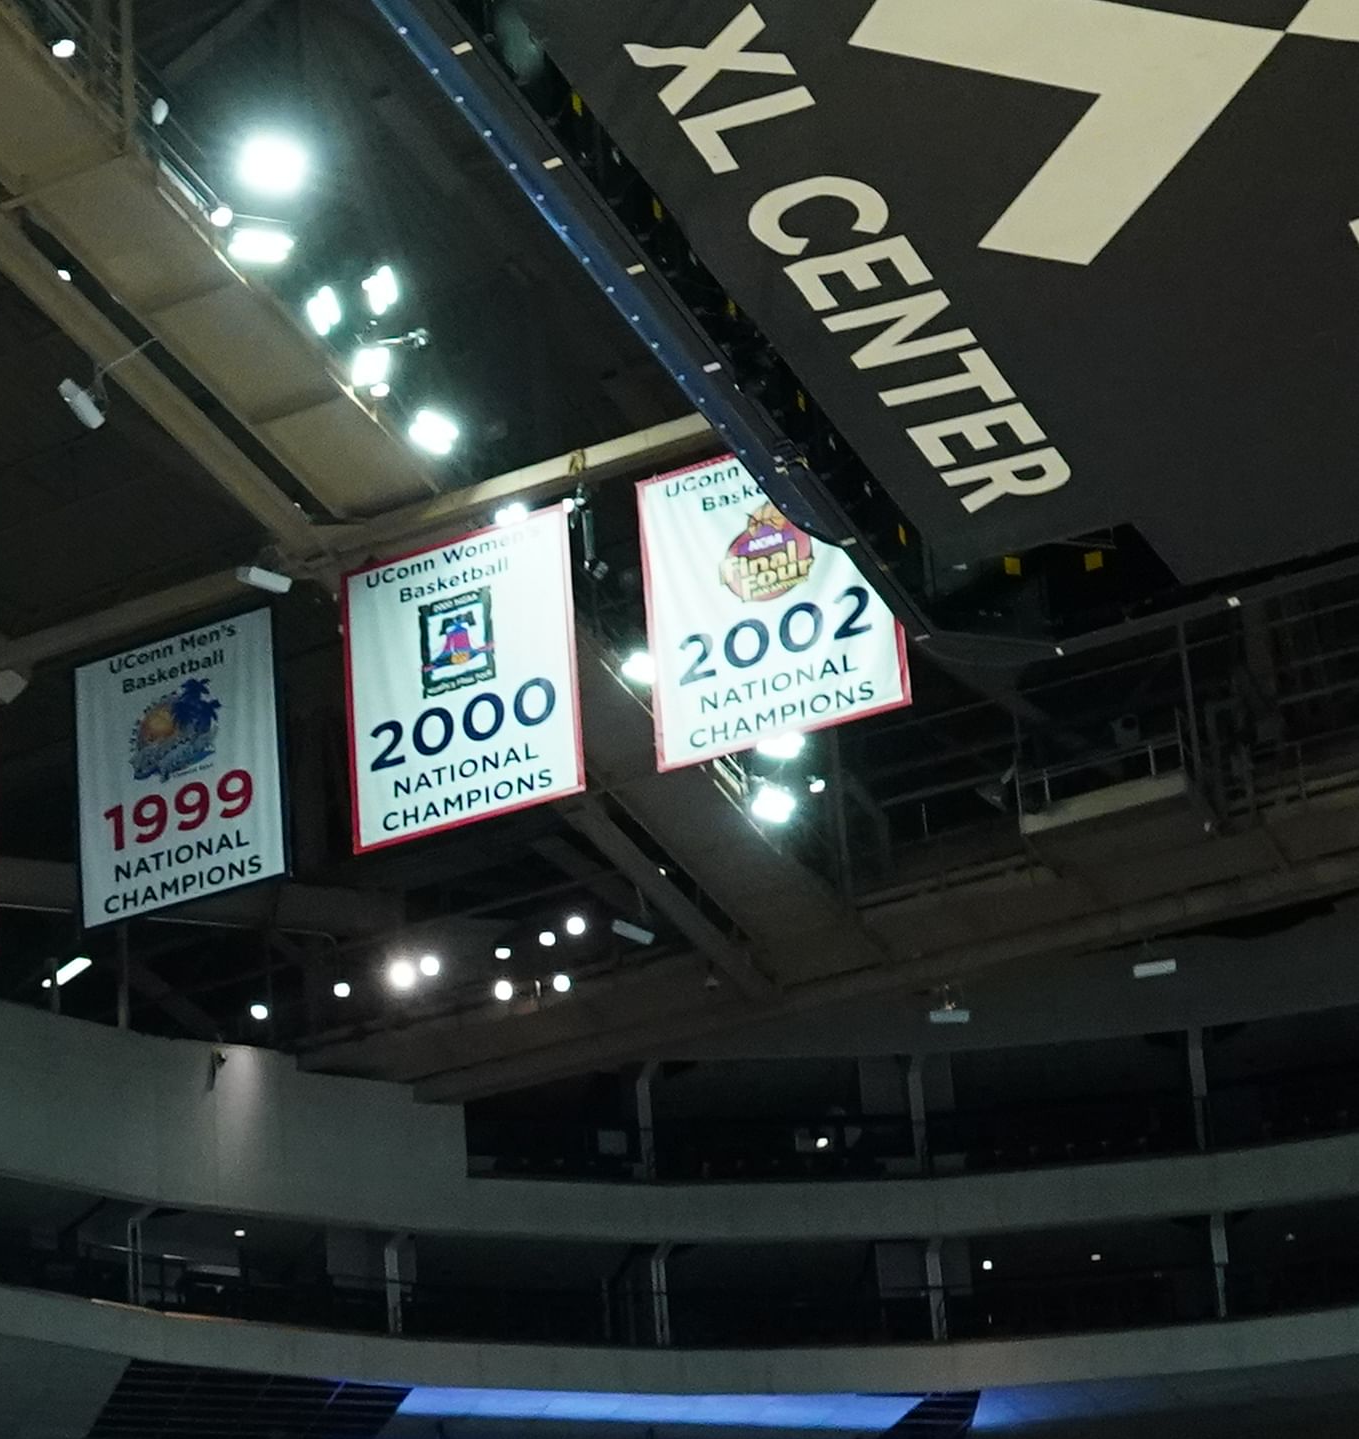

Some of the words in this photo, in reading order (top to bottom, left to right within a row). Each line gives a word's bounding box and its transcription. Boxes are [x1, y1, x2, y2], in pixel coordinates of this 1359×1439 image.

[623, 3, 817, 174] XL
[748, 175, 1072, 514] CENTER
[665, 464, 740, 498] UConn
[366, 557, 435, 589] UConn
[399, 557, 509, 603] Basketball
[109, 644, 174, 675] UConn
[180, 623, 237, 653] Men's
[679, 585, 872, 687] 2002
[122, 650, 224, 694] Basketball
[700, 654, 859, 714] NATIONAL
[369, 677, 556, 773] 2000
[689, 681, 875, 748] CHAMPIONS
[382, 768, 553, 832] CHAMPIONS
[394, 743, 539, 798] NATIONAL
[103, 769, 254, 851] 1999
[104, 855, 262, 914] CHAMPIONS
[114, 829, 249, 883] NATIONAL
